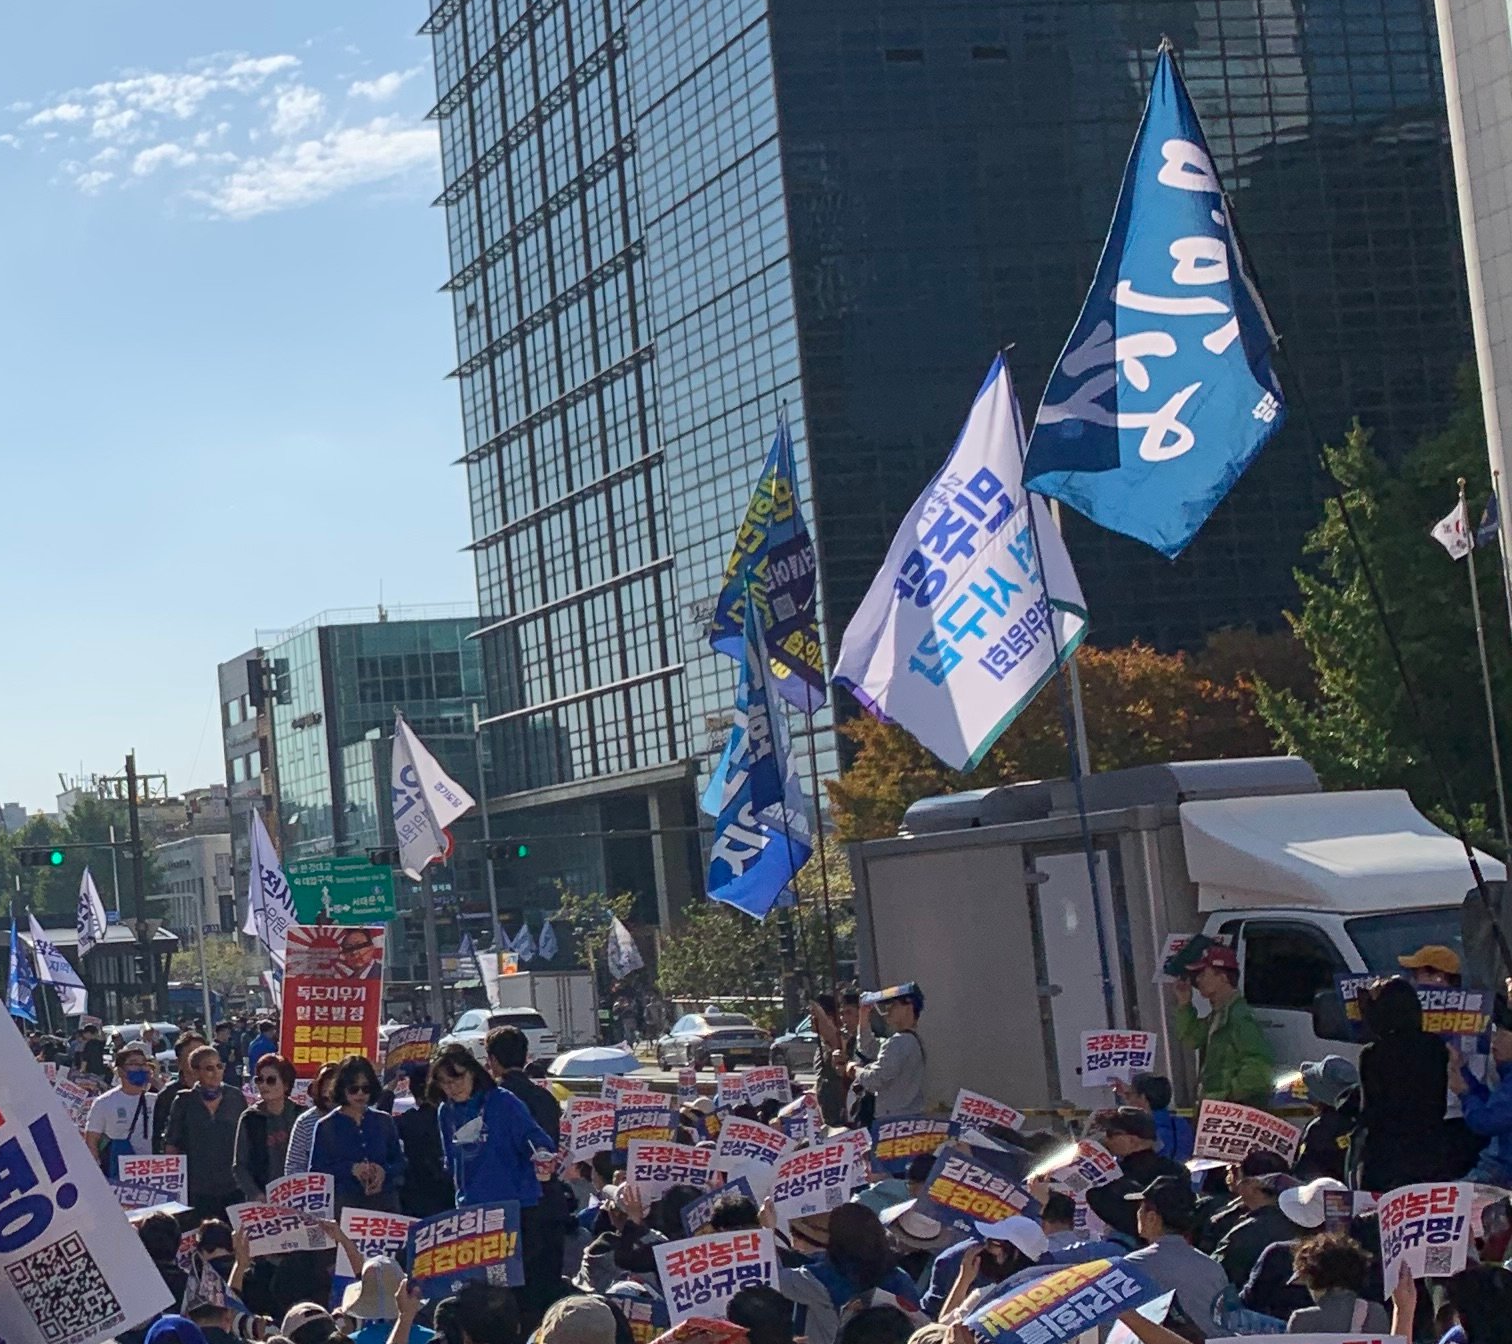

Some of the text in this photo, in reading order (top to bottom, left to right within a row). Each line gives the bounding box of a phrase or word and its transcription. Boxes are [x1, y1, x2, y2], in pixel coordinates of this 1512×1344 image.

[297, 986, 367, 1002] 독도지우기
[1422, 1012, 1491, 1033] 검하라!
[1087, 1033, 1148, 1051] 국정농단
[1087, 1052, 1151, 1070] 진상규명!
[621, 1094, 666, 1105] 국정농단
[961, 1097, 1017, 1122] 국정농단
[578, 1113, 614, 1134] 국정농
[618, 1111, 672, 1130] 김건희를
[878, 1119, 949, 1136] 김건희를
[575, 1129, 614, 1149] 진상규
[726, 1123, 786, 1149] 국정농단
[124, 1158, 181, 1176] 국정농단
[636, 1147, 711, 1166] 국정농단
[777, 1146, 845, 1179] 국정농단
[635, 1165, 715, 1185] 진상규명!
[773, 1164, 848, 1203] 진상규명!
[941, 1156, 1030, 1204] 김건희를
[350, 1216, 409, 1237] 국정농
[414, 1208, 505, 1253] 김건희를
[412, 1232, 517, 1278] 특검하라!
[665, 1233, 761, 1279] 국정농단
[672, 1262, 772, 1313] 진상규명!
